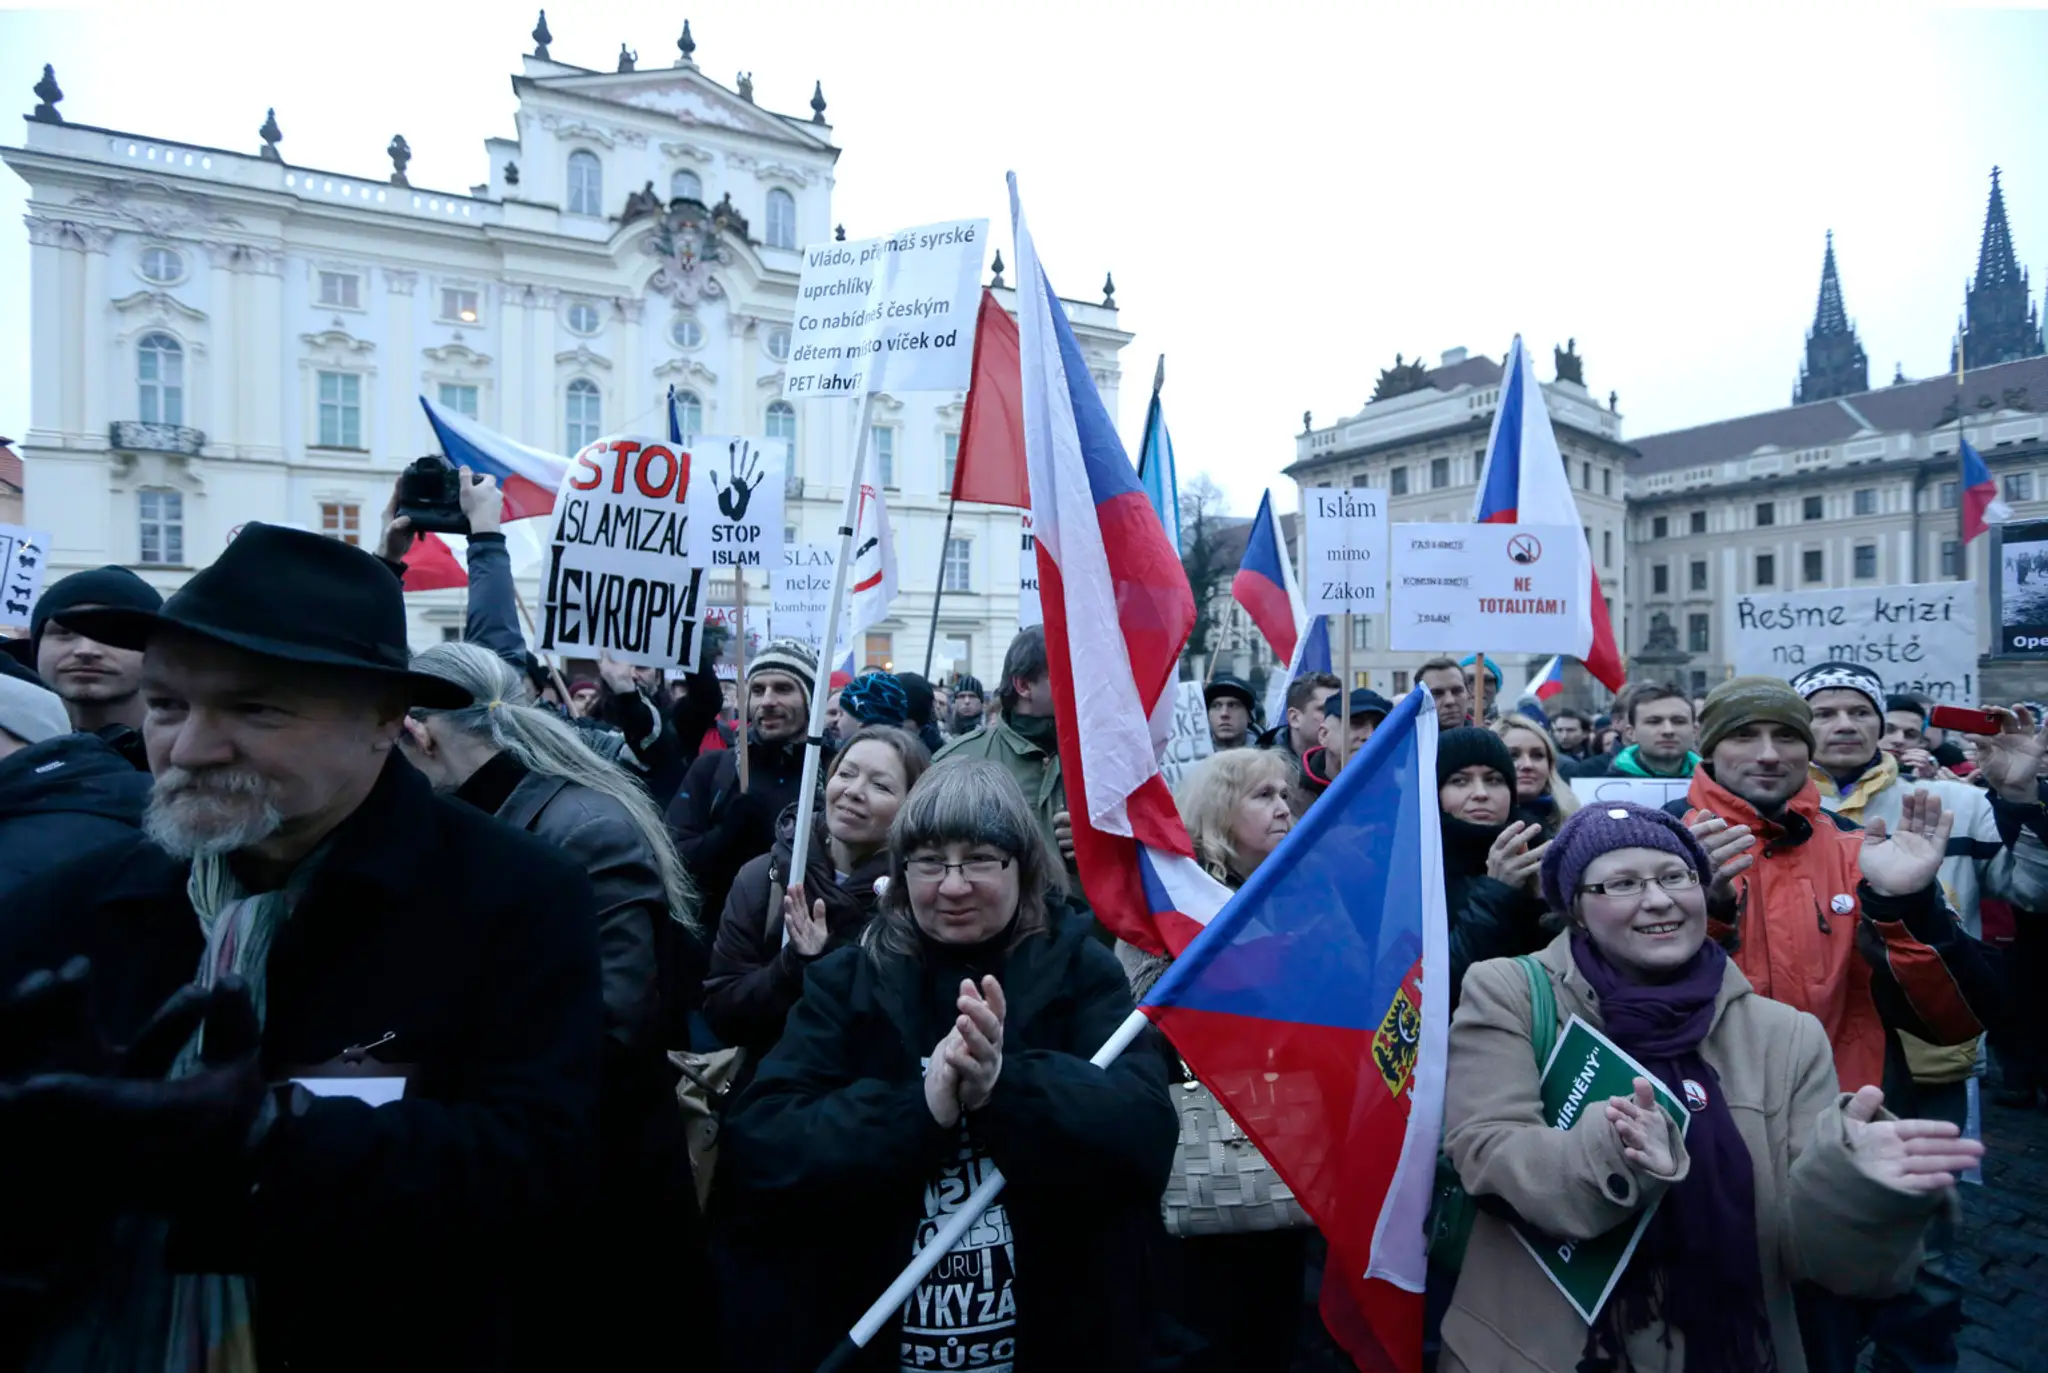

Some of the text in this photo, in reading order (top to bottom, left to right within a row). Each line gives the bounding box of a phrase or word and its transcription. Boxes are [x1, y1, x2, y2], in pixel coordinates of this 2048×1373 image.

[809, 248, 855, 268] Vládo,
[920, 224, 975, 250] syrské
[799, 315, 817, 331] Co
[887, 297, 949, 319] českým
[793, 344, 841, 362] dětem
[887, 331, 929, 351] víček
[934, 329, 957, 347] od
[788, 375, 815, 392] PET
[1318, 496, 1376, 518] Islám
[711, 524, 761, 543] STOP
[712, 550, 760, 566] ISLAM
[1327, 545, 1370, 561] mimo
[786, 574, 831, 590] nelze
[1322, 582, 1375, 601] Zákon
[1514, 576, 1532, 592] NE
[1738, 596, 1955, 630] Řešme krizi
[1773, 644, 1805, 665] na
